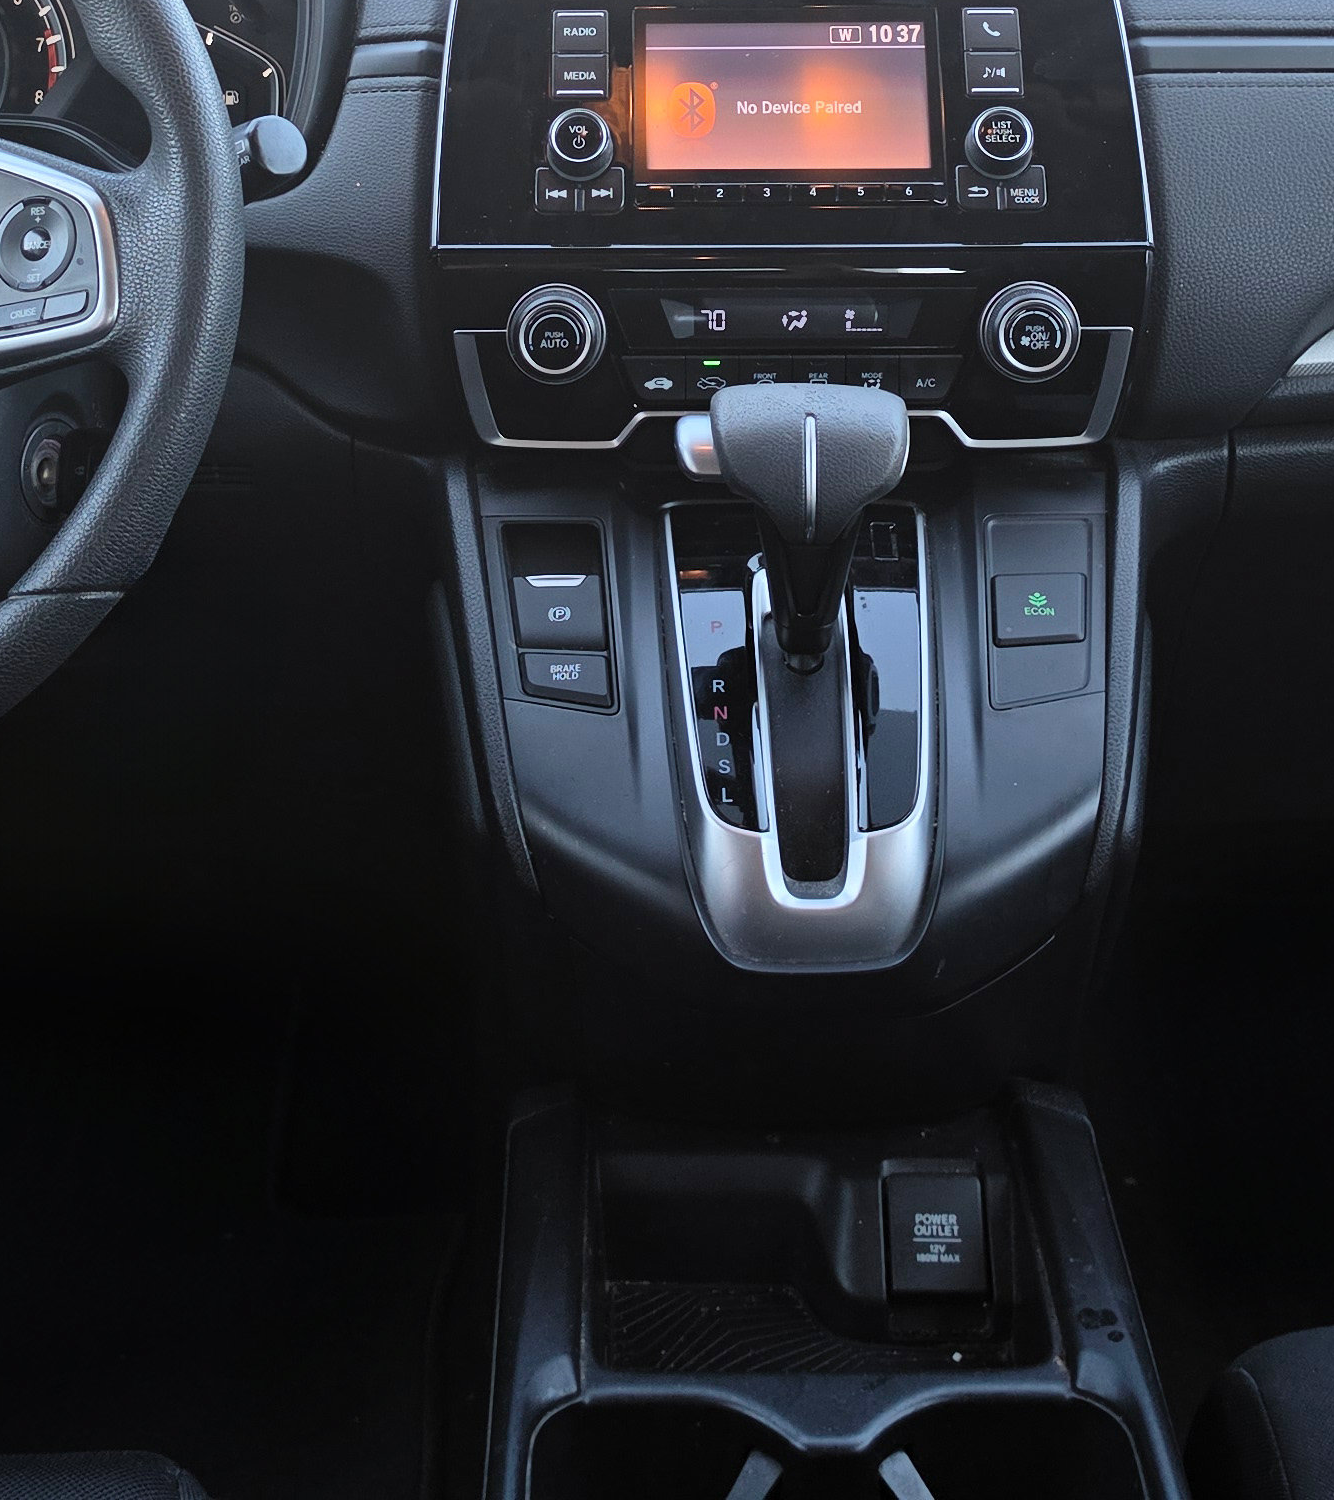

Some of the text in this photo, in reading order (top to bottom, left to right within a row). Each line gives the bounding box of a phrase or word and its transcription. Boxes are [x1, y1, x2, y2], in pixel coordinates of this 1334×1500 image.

[563, 27, 597, 37] RADIO
[35, 38, 45, 52] 7
[563, 71, 597, 81] MEDIA
[34, 89, 44, 105] 8
[737, 100, 862, 114] No Device Paired
[992, 120, 1012, 129] LIST
[568, 125, 589, 135] VOL
[985, 135, 1021, 143] SELECT
[668, 188, 675, 198] 1
[716, 188, 724, 198] 2
[763, 187, 771, 197] 3
[809, 187, 817, 197] 4
[857, 186, 865, 196] 5
[905, 186, 913, 196] 6
[1010, 188, 1039, 197] MENU
[1014, 196, 1040, 204] CLOCK
[30, 206, 46, 216] RES
[27, 273, 41, 283] SET
[9, 306, 37, 320] CRUISE
[700, 309, 726, 331] 70
[1030, 332, 1050, 341] ON/
[539, 338, 569, 349] AUTO
[1030, 341, 1051, 350] OFF
[753, 372, 777, 381] FRONT
[808, 372, 829, 380] REAR
[861, 371, 884, 380] MODE
[915, 377, 936, 388] A/C
[1023, 606, 1056, 616] ECON
[710, 620, 723, 634] P
[549, 663, 582, 674] BRAKE
[552, 671, 579, 681] HOLD
[712, 679, 726, 693] R
[713, 706, 728, 720] N
[716, 732, 730, 747] D
[718, 759, 731, 774] S
[721, 787, 734, 803] L
[914, 1212, 957, 1225] POWER
[913, 1224, 960, 1237] OUTLET
